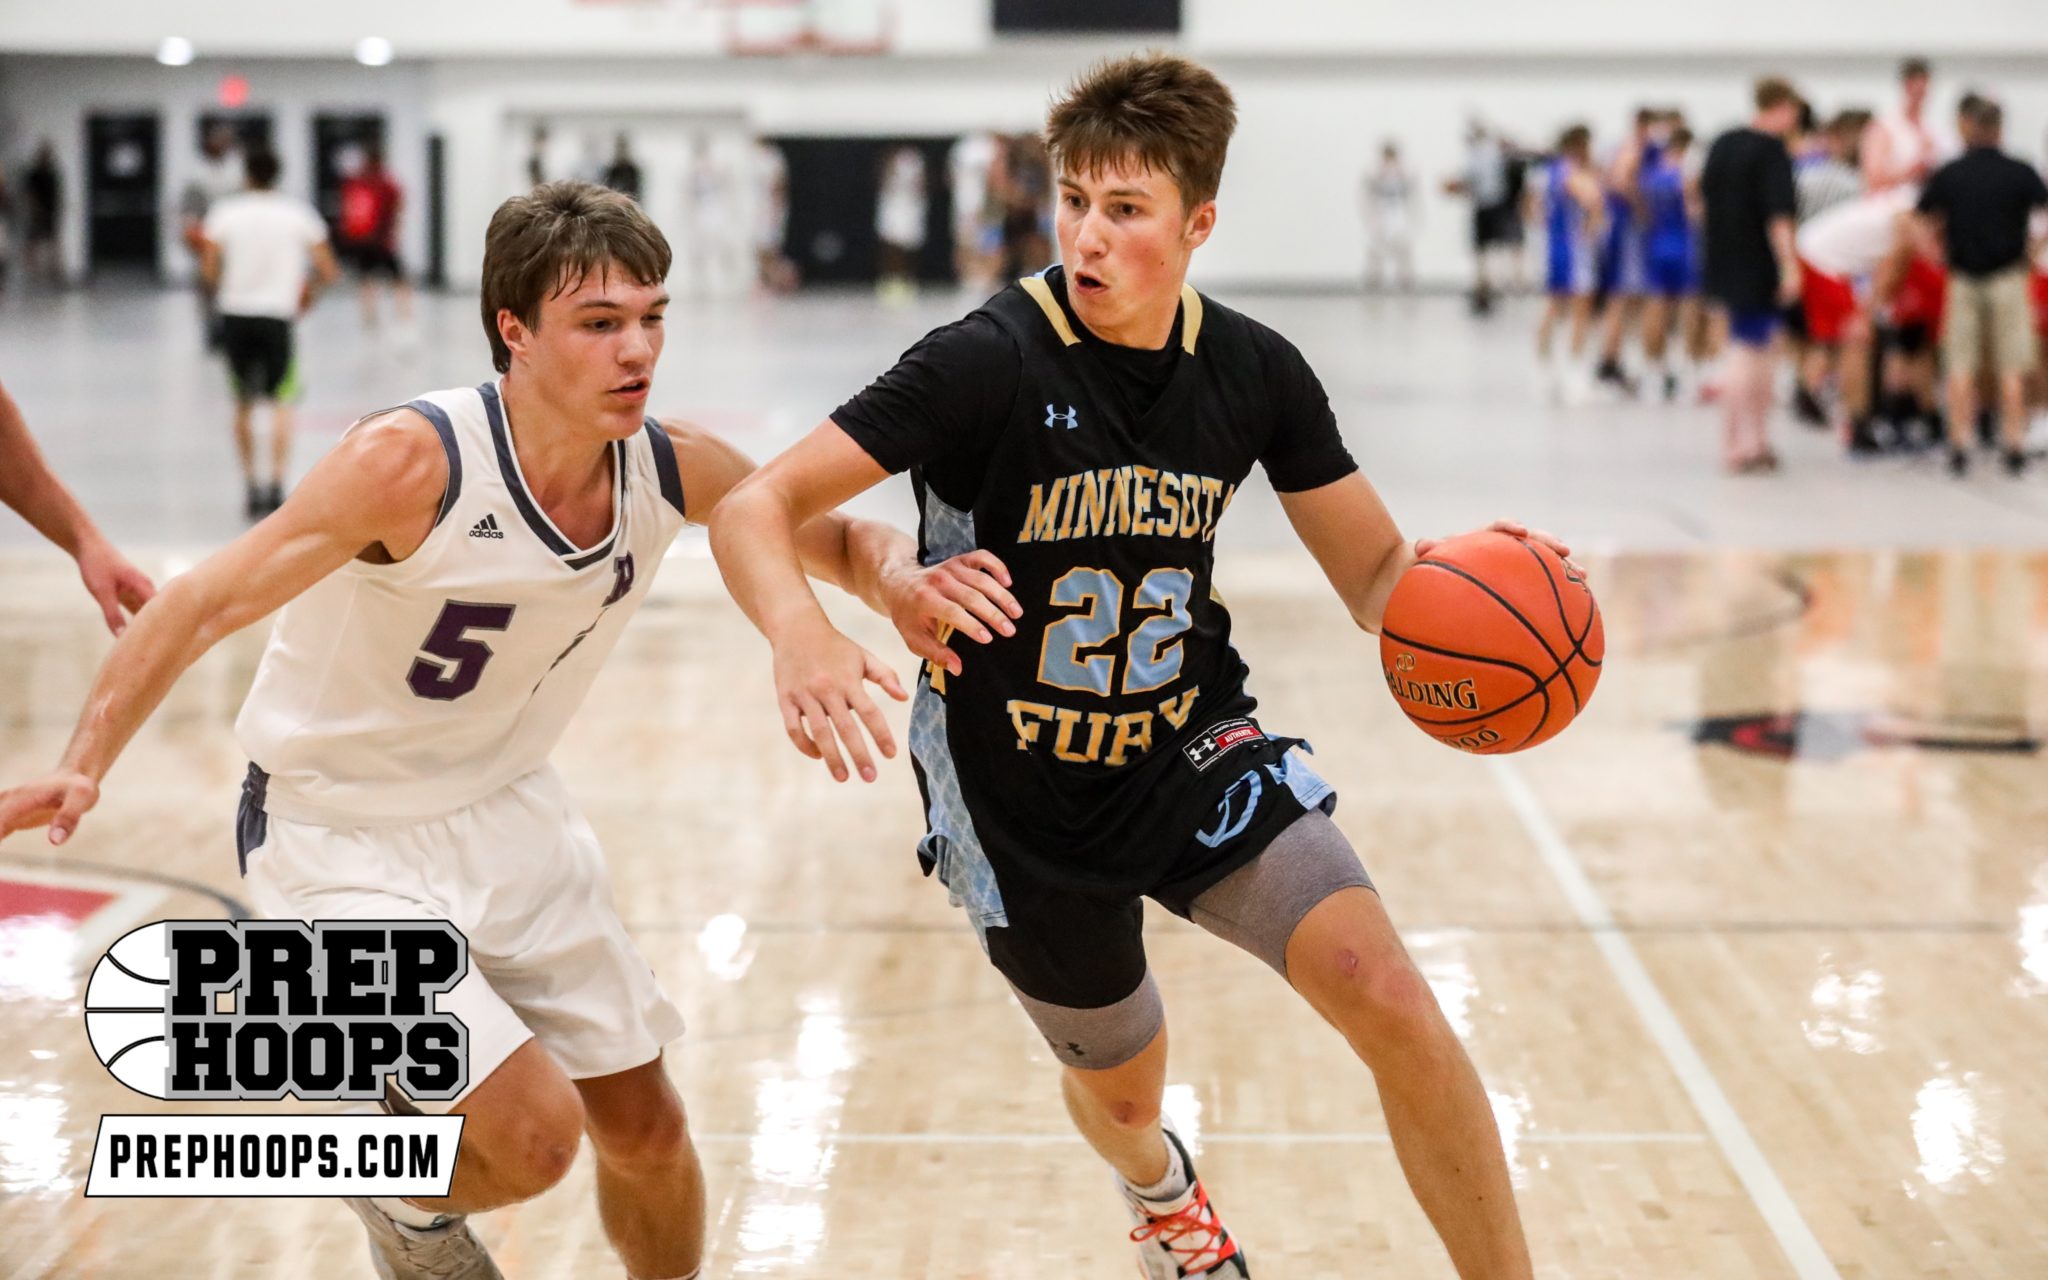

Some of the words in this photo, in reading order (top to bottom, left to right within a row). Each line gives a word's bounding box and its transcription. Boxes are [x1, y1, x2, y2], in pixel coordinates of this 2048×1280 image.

[469, 528, 504, 539] adidas
[406, 599, 516, 701] 5
[1037, 566, 1194, 697] 22
[1007, 685, 1199, 766] FURY
